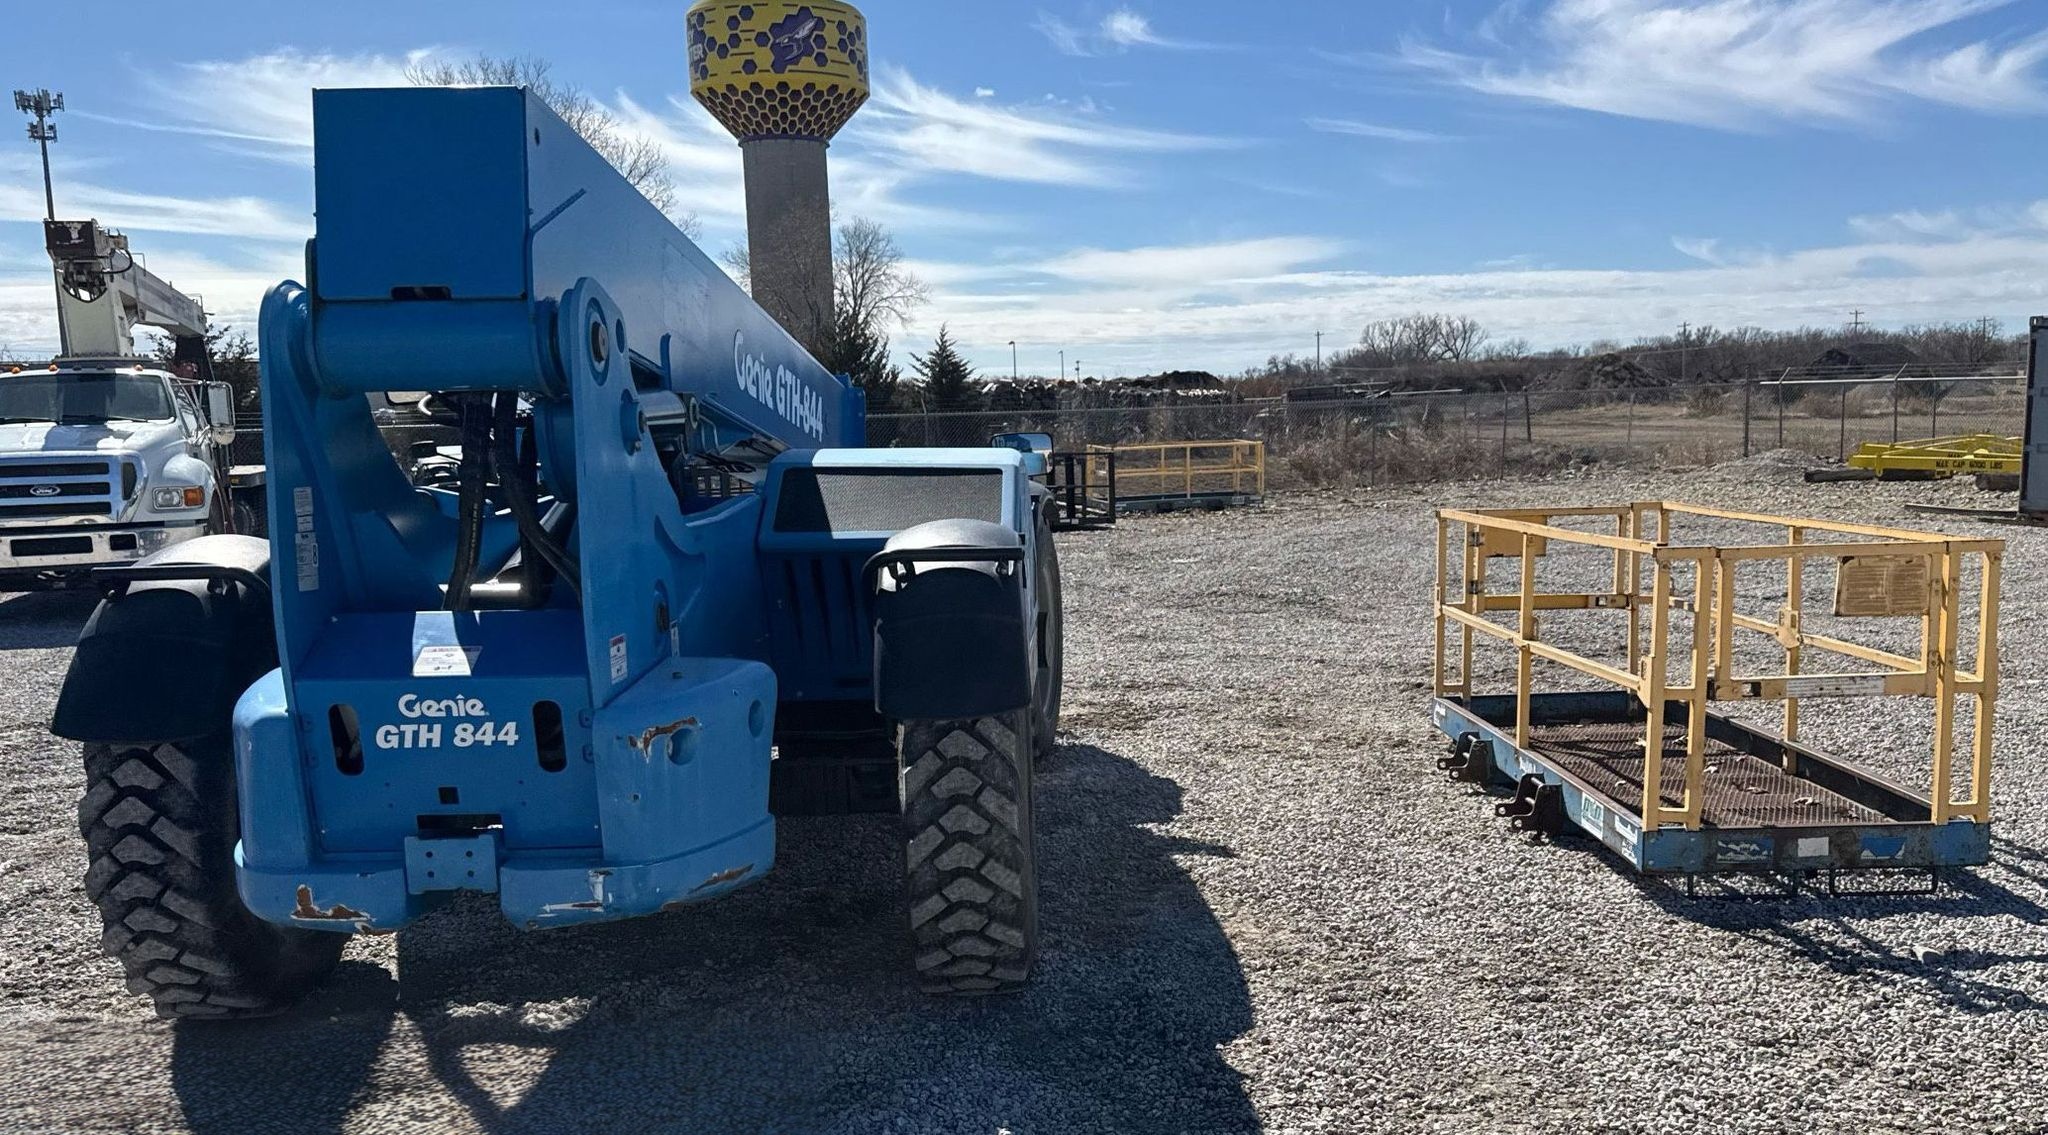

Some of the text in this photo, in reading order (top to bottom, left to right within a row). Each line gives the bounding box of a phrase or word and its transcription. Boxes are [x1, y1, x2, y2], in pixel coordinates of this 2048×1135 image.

[734, 329, 823, 442] Genie GTH-844
[1935, 460, 1948, 468] MAX
[1952, 460, 1965, 468] CAP
[1990, 461, 2003, 469] LBS
[398, 693, 486, 718] Genie
[375, 721, 519, 749] GTH 844
